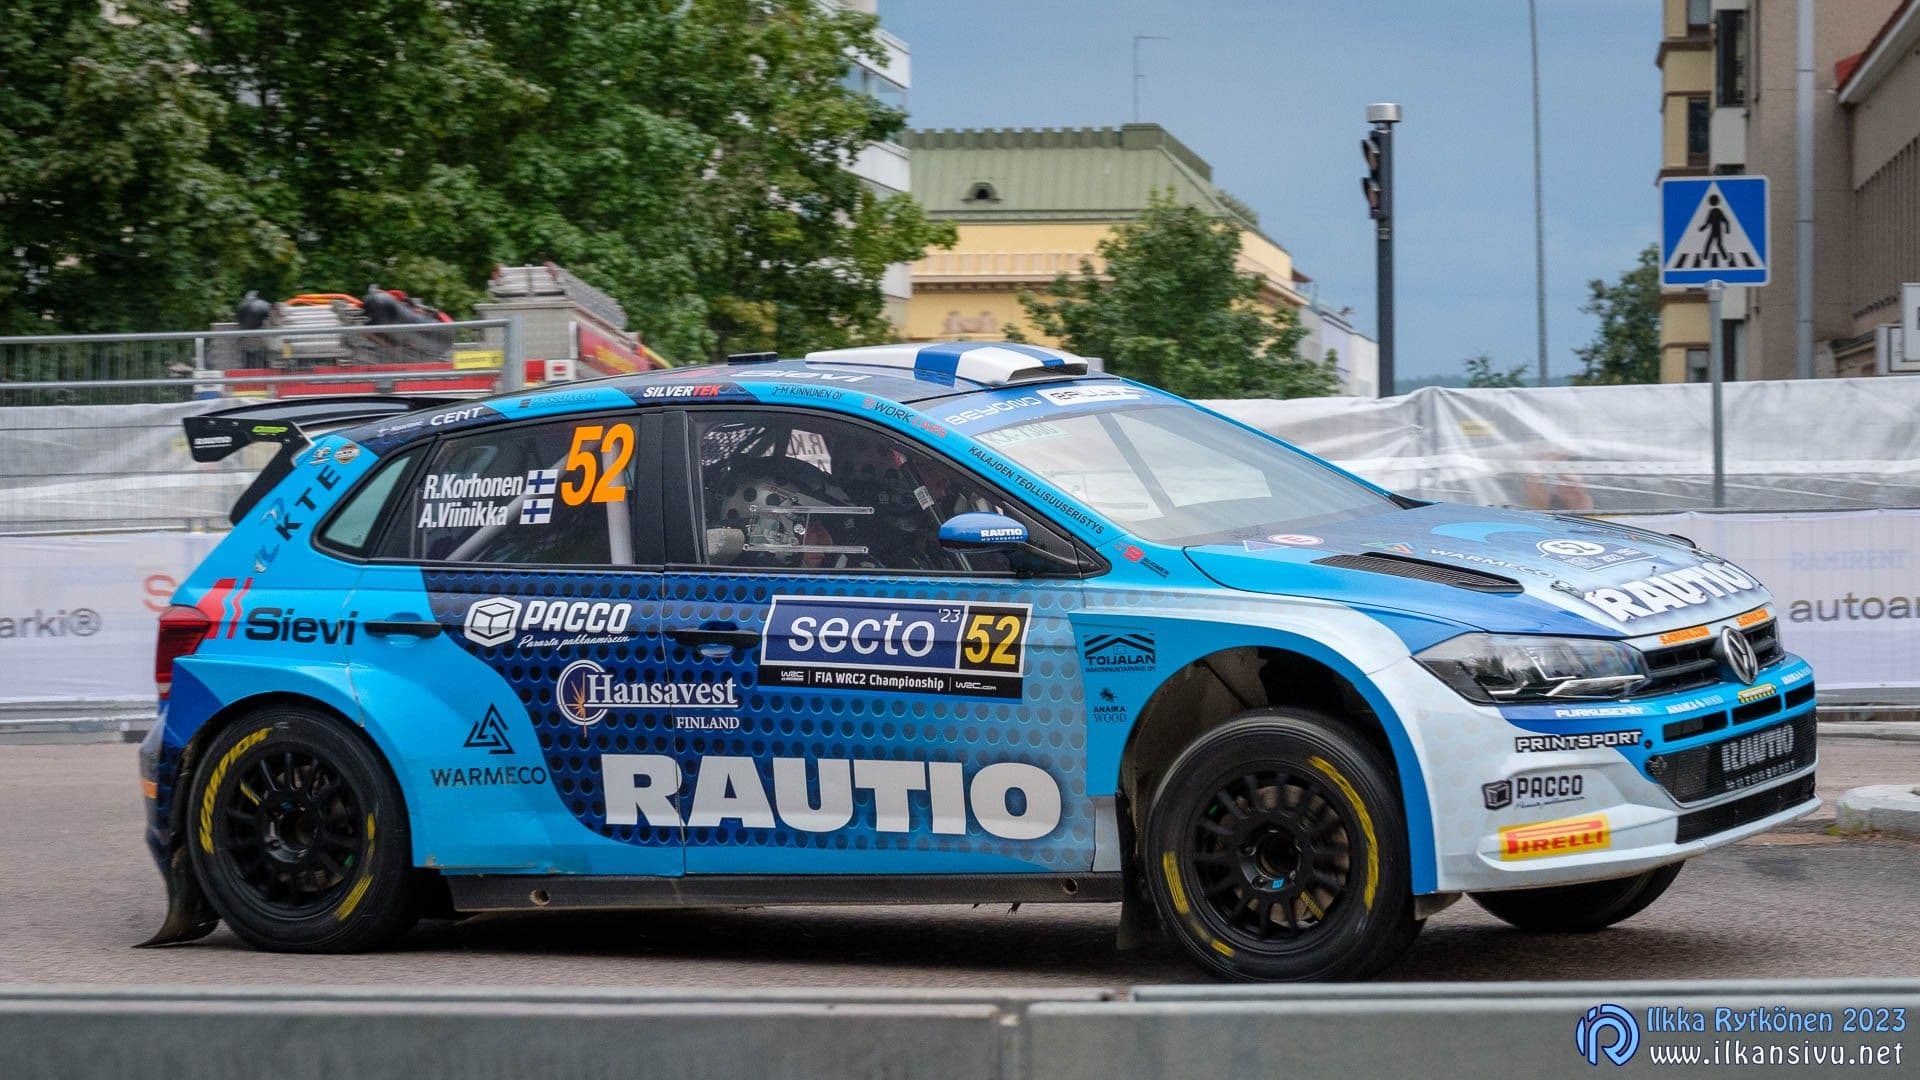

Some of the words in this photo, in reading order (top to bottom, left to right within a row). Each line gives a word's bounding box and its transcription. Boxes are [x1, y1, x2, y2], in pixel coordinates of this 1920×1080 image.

[643, 384, 723, 398] SILVERTEK
[430, 407, 484, 426] CENT
[561, 423, 635, 507] 52
[968, 446, 1014, 479] KALAJOEN
[423, 473, 524, 500] R.Korhonen
[417, 500, 508, 529] A.Viinikka
[981, 528, 1023, 538] RAUTIO
[1584, 562, 1753, 622] RAUTIO
[245, 607, 359, 646] Sievi
[521, 600, 632, 634] PACCO
[518, 635, 559, 648] Parasta
[787, 608, 936, 657] secto
[964, 615, 1020, 666] 52
[1087, 655, 1155, 665] TOIJALAN
[586, 673, 738, 704] Hansavest
[815, 671, 833, 684] FIA
[836, 672, 867, 685] WRC2
[869, 674, 945, 691] Championship
[676, 716, 740, 730] FINLAND
[1516, 731, 1642, 751] PRINTSPORT
[431, 766, 547, 788] WARMECO
[1517, 775, 1583, 799] PACCO
[599, 753, 1062, 840] RAUTIO
[1507, 820, 1603, 855] PIRELLI
